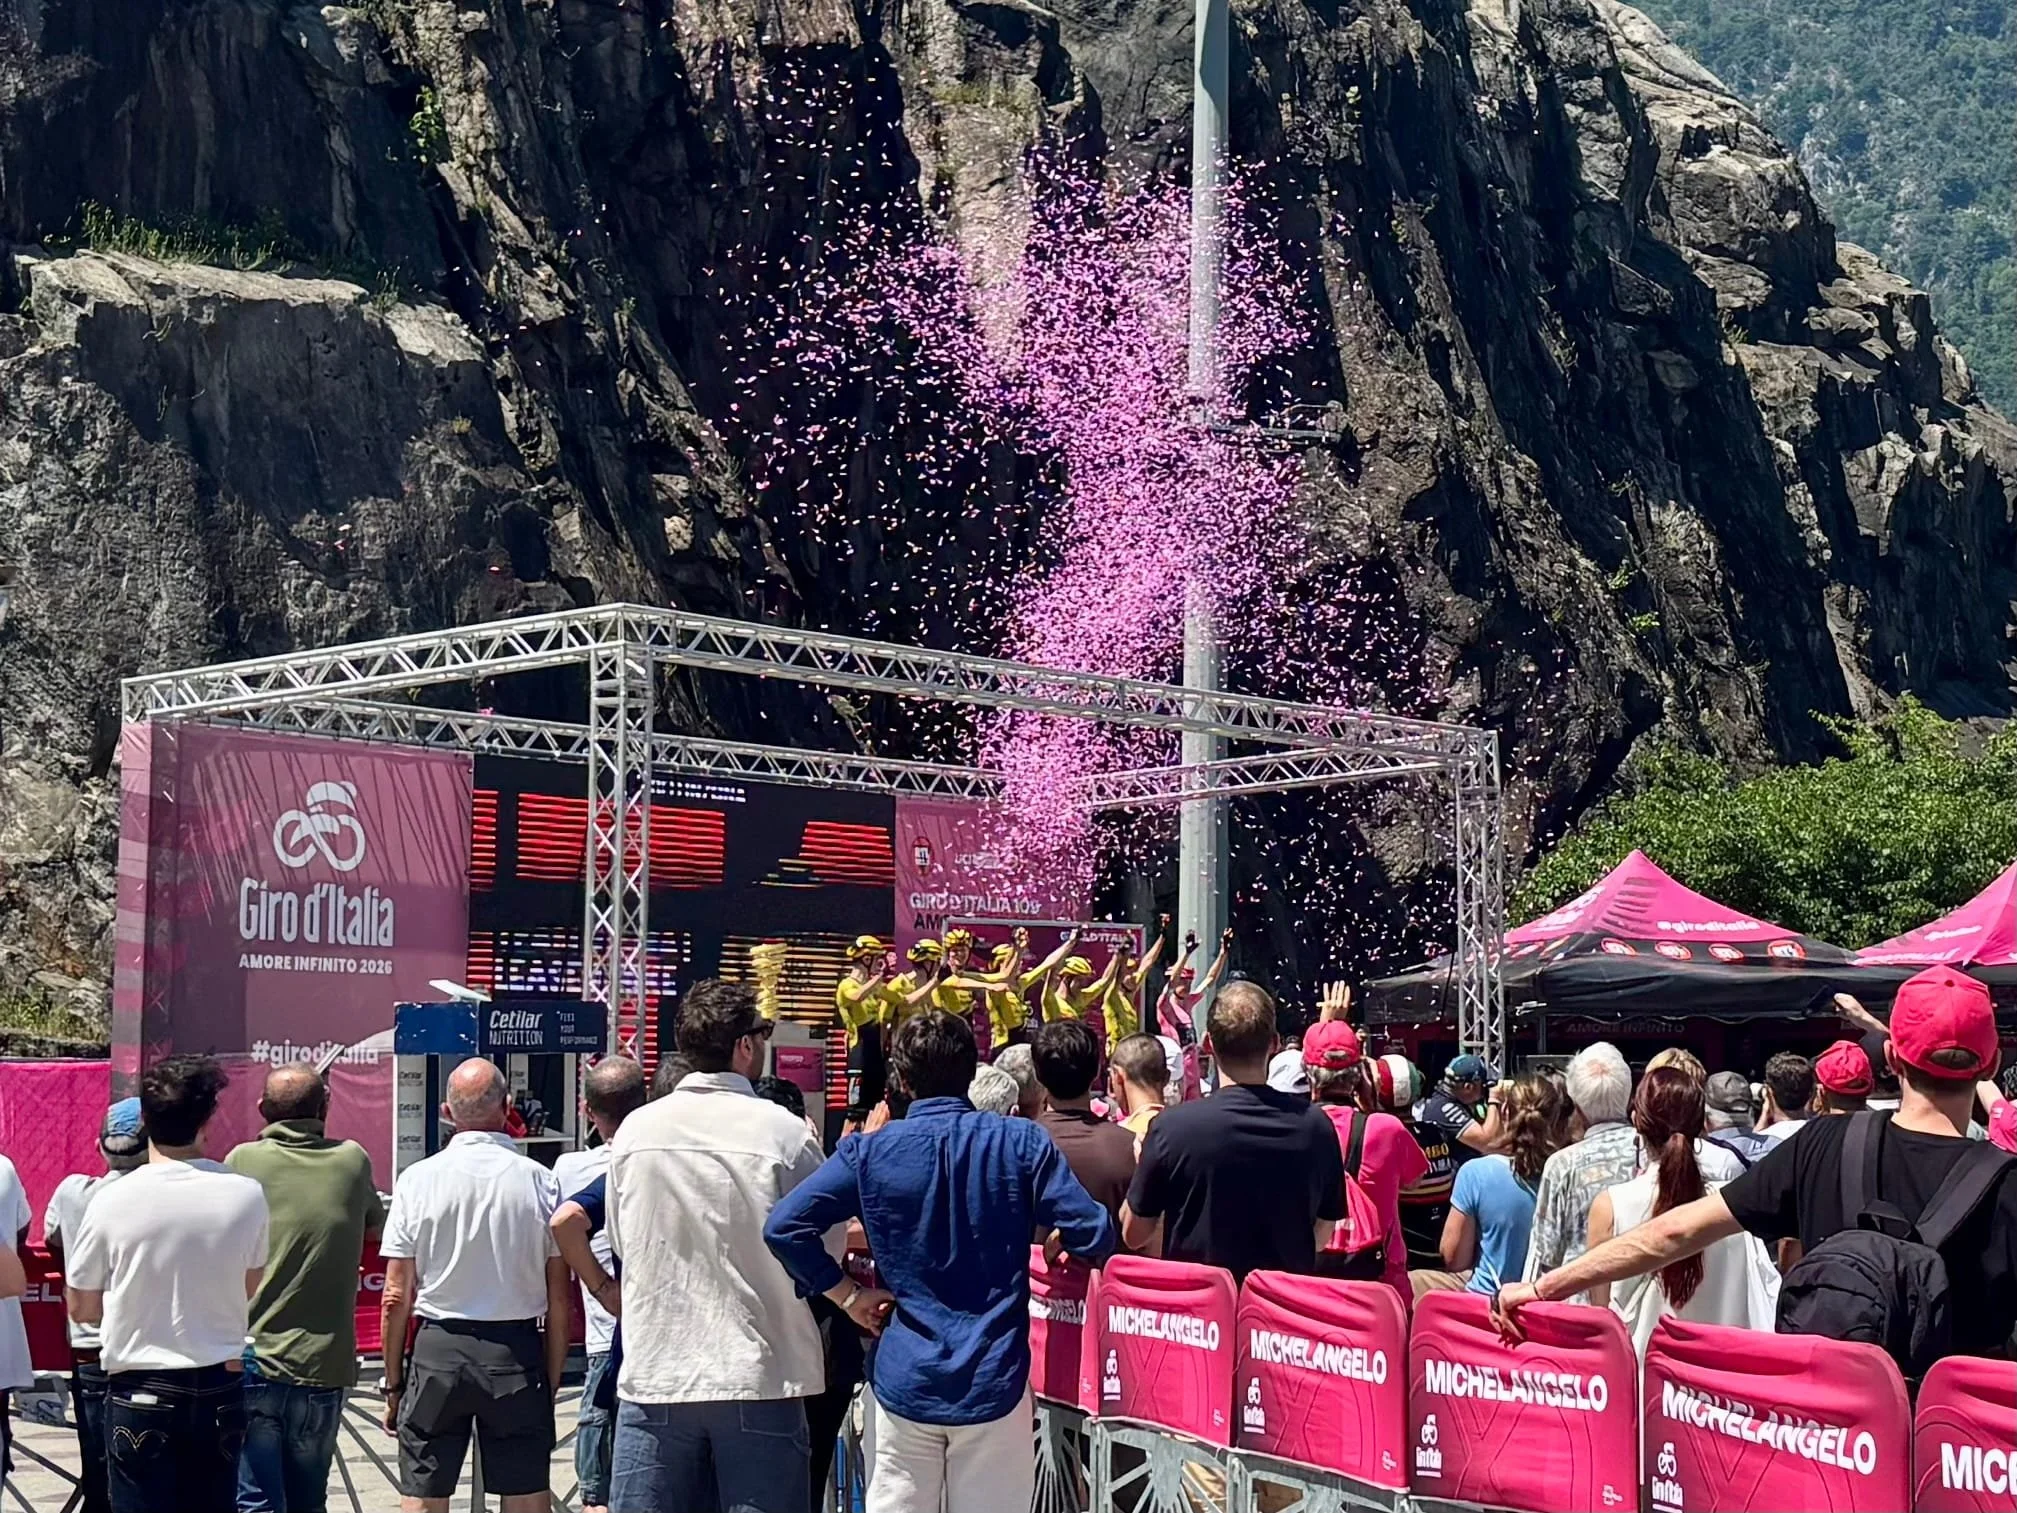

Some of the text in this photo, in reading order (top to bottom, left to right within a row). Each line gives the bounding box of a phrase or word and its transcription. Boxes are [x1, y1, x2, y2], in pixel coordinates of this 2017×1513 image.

[239, 877, 394, 947] Giro d'Italia
[910, 891, 947, 910] GIRO
[239, 953, 393, 974] AMORE INFINITO 2026
[489, 1010, 543, 1029] Cetilar
[489, 1030, 543, 1046] NUTRITION
[251, 1040, 379, 1068] #girodalia
[1108, 1305, 1220, 1351] MICHELANGELO
[1250, 1328, 1387, 1385] MICHELANGELO
[1425, 1359, 1608, 1412] MICHELANGELO
[1662, 1380, 1877, 1476] MICHELANGELO
